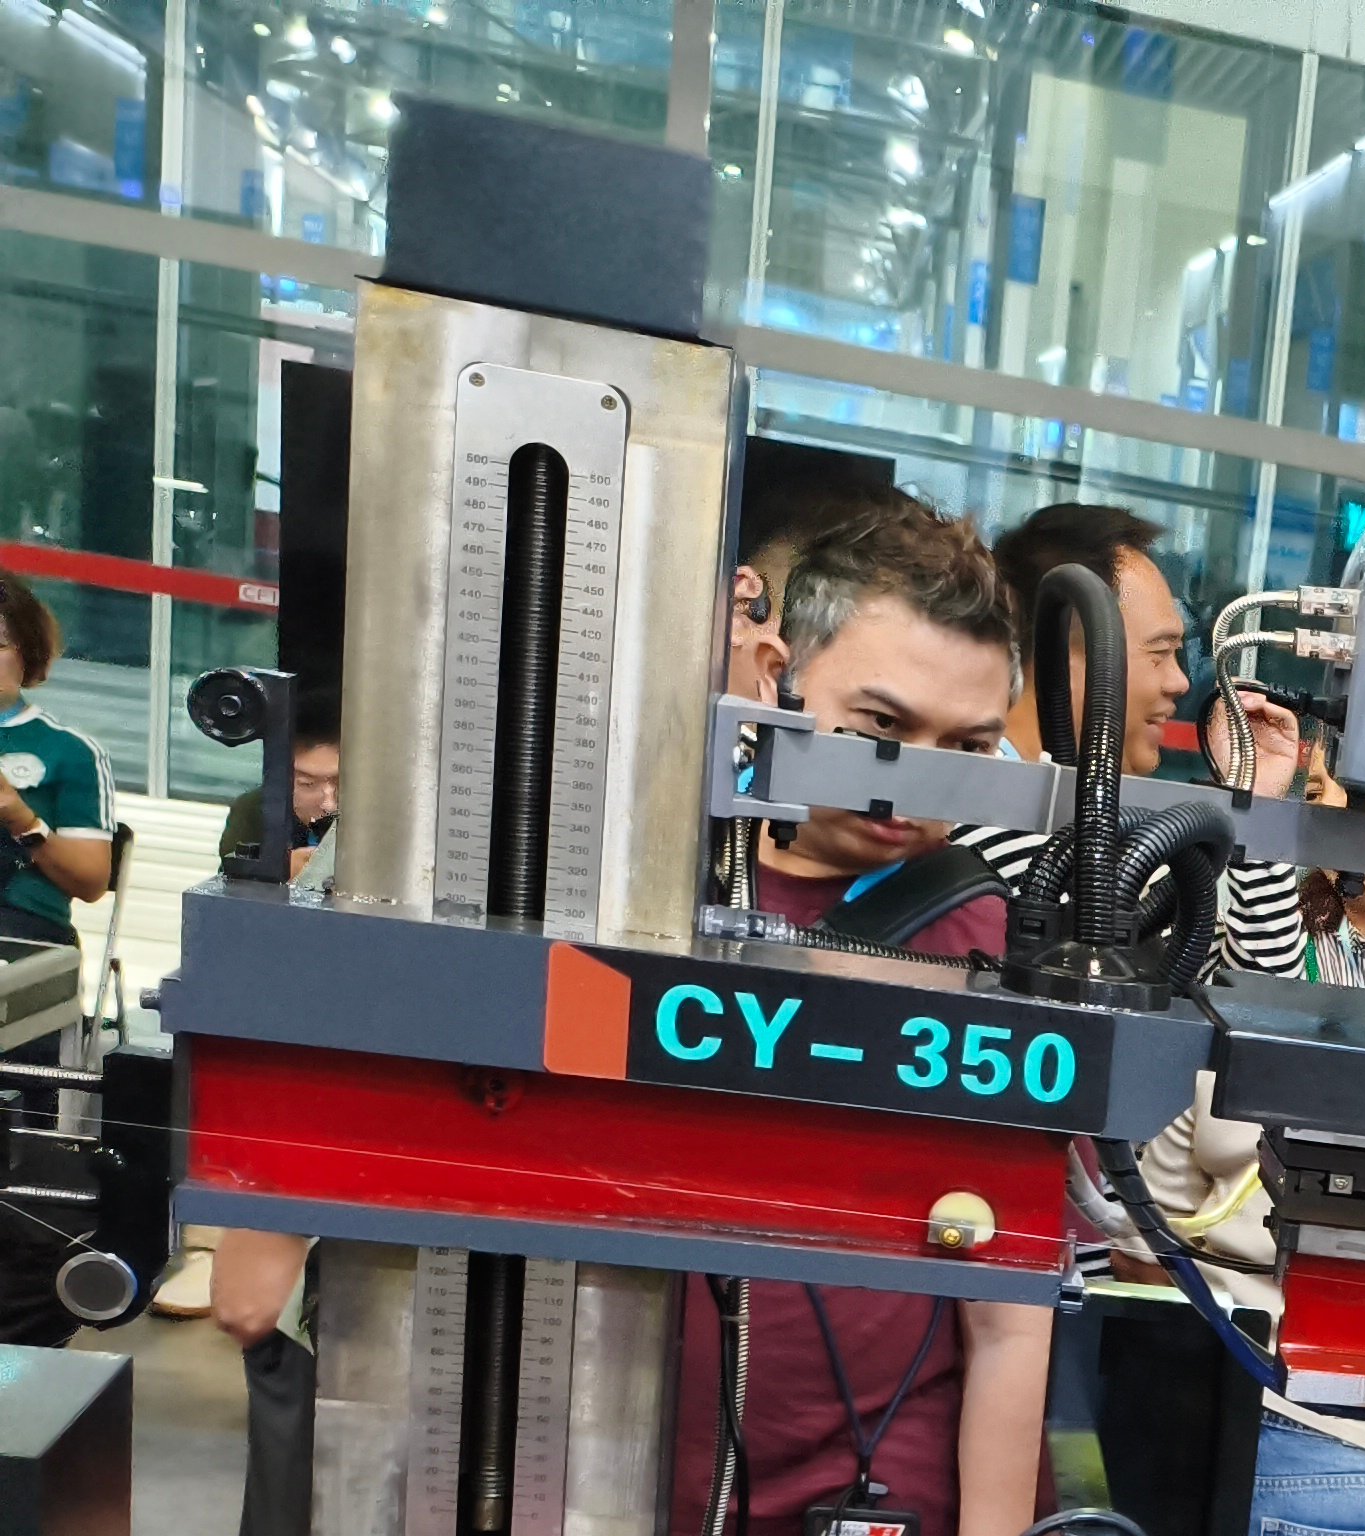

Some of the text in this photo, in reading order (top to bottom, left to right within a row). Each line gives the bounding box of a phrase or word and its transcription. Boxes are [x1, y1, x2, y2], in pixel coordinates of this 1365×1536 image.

[466, 453, 488, 464] 500
[465, 476, 487, 487] 490
[589, 474, 611, 486] 500
[464, 499, 486, 510] 480
[588, 497, 609, 508] 490
[463, 522, 485, 532] 470
[587, 520, 608, 530] 480
[586, 542, 607, 552] 470
[461, 566, 482, 577] 450
[584, 564, 606, 574] 460
[460, 588, 481, 599] 440
[583, 585, 604, 596] 450
[459, 611, 480, 621] 430
[582, 607, 603, 618] 440
[457, 655, 478, 665] 410
[579, 652, 600, 662] 420
[456, 676, 477, 687] 400
[578, 674, 599, 684] 410
[453, 742, 474, 752] 370
[574, 738, 595, 749] 380
[573, 759, 594, 769] 370
[451, 786, 471, 796] 350
[570, 802, 591, 813] 350
[450, 808, 470, 818] 340
[449, 829, 470, 839] 330
[569, 824, 590, 834] 340
[568, 845, 589, 855] 330
[567, 866, 588, 876] 320
[447, 872, 467, 882] 310
[566, 888, 587, 898] 310
[564, 909, 585, 919] 300
[897, 1016, 1076, 1103] 350
